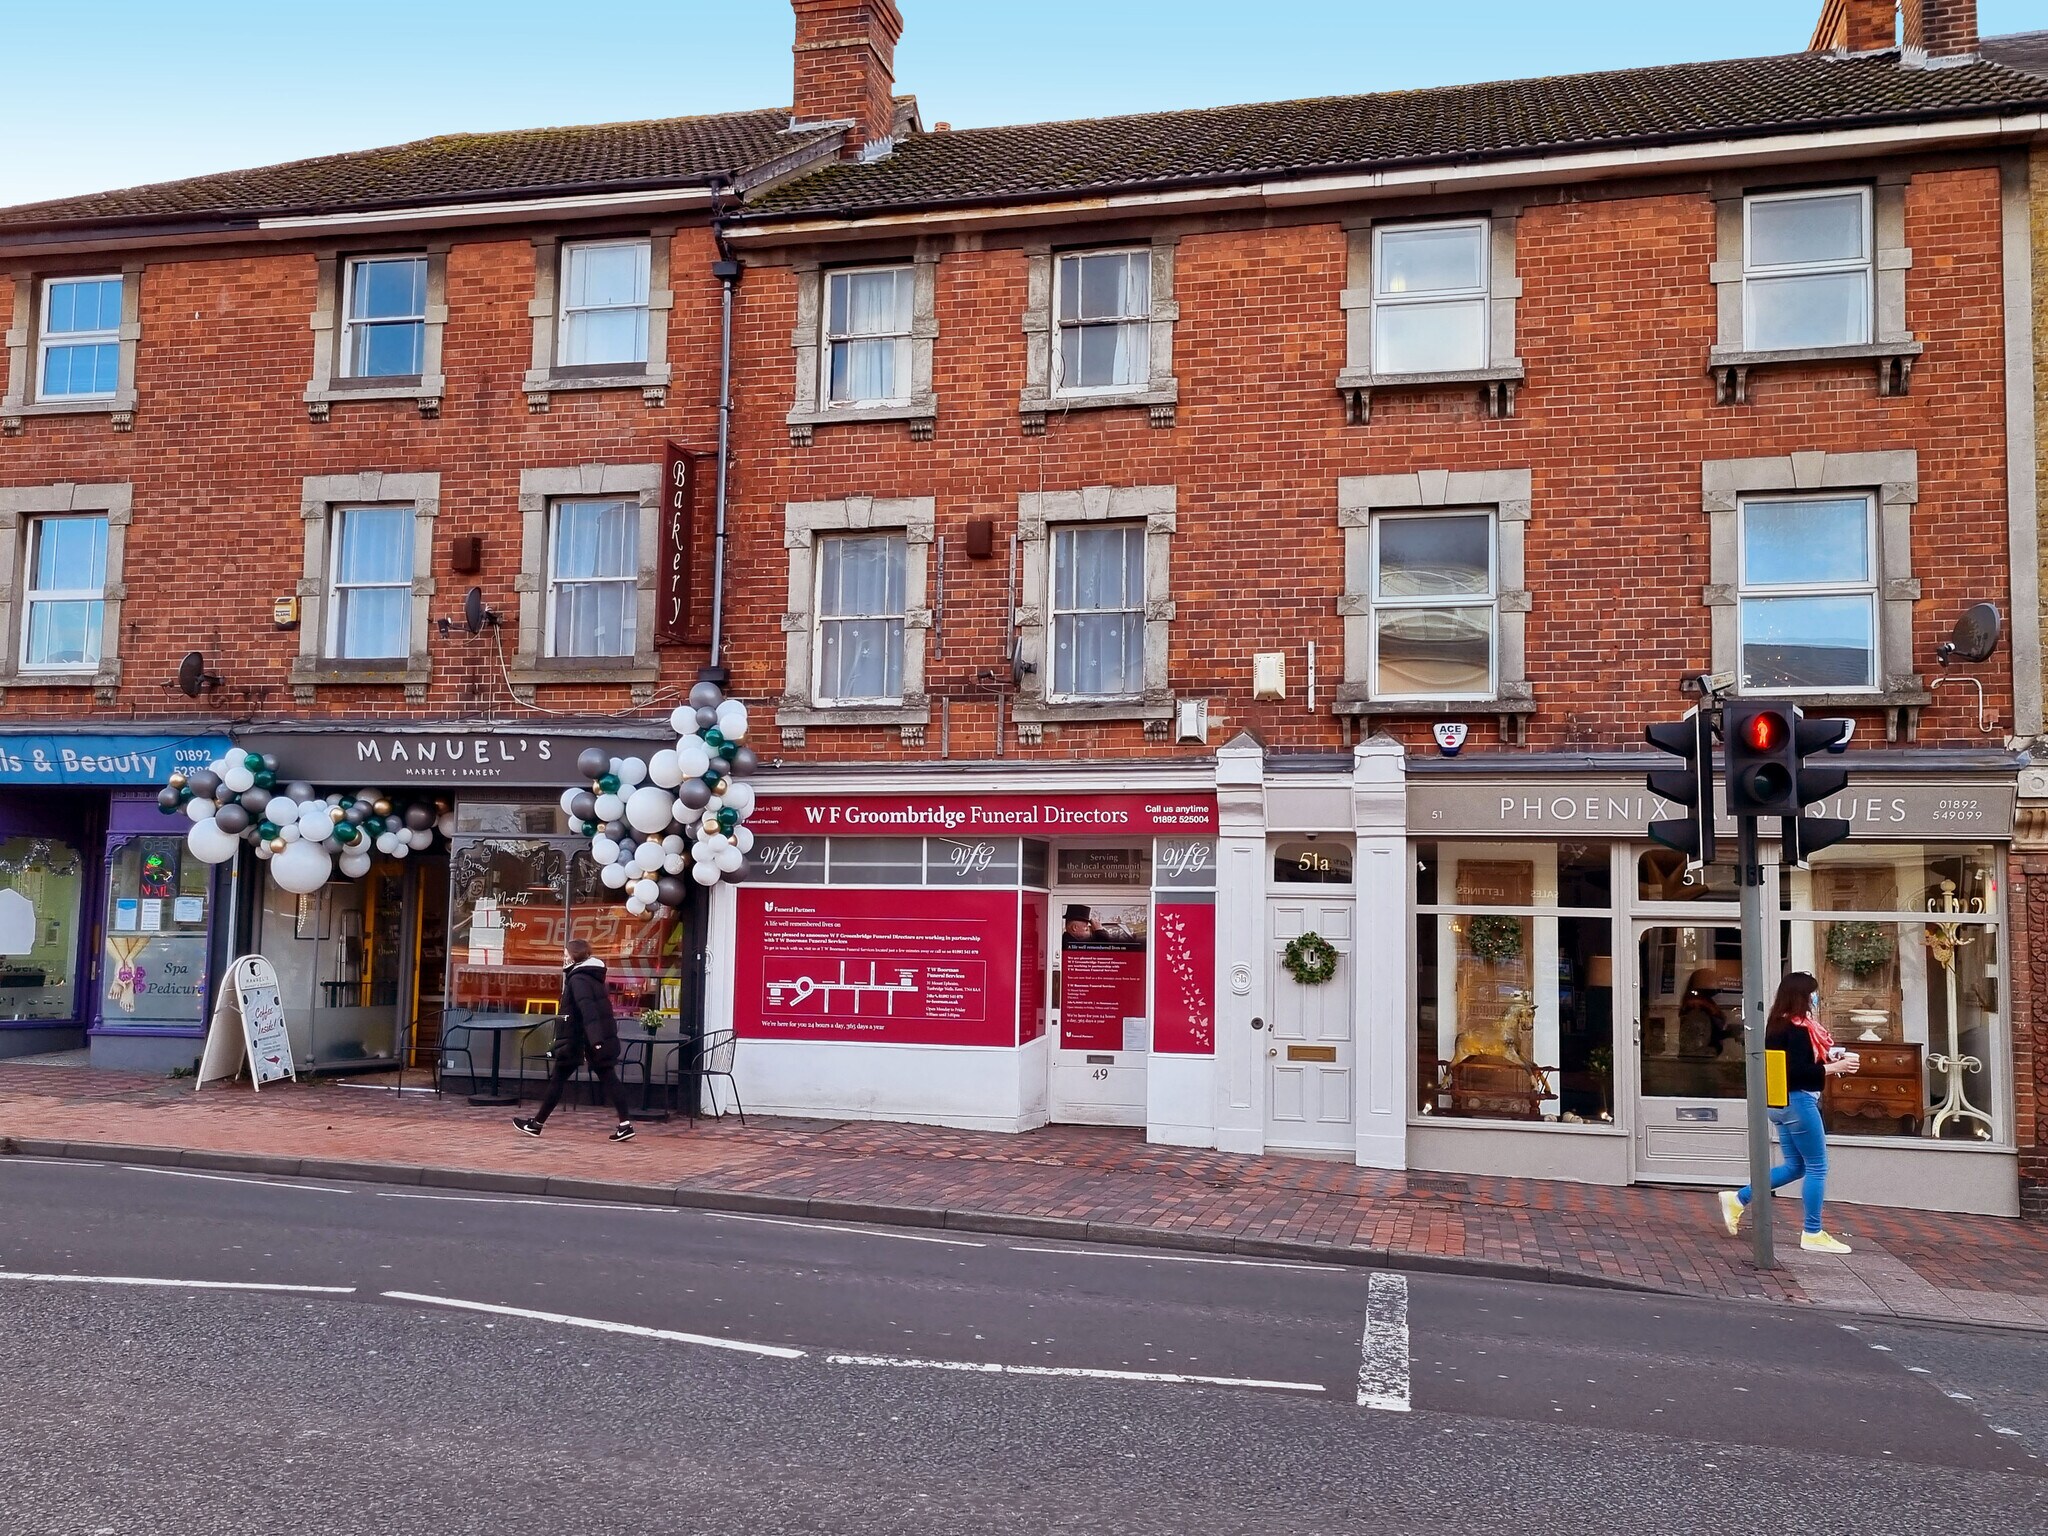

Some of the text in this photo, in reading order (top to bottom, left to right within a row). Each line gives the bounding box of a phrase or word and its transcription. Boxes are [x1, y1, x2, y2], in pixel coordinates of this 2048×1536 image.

[669, 460, 685, 625] Bakery
[175, 750, 212, 762] 01892
[357, 739, 552, 764] MANUEL'S
[0, 748, 156, 778] ls & Beauty
[1145, 805, 1161, 813] Call
[1175, 806, 1209, 815] anytime
[1500, 797, 1668, 820] PHOENIX
[1939, 800, 1977, 809] 01892
[805, 806, 1128, 828] W F Groombridge Funeral Directors
[1152, 816, 1209, 824] 01892 525004
[1431, 810, 1444, 819] 51
[1932, 811, 1982, 820] 549099
[143, 840, 178, 850] OPEN
[461, 854, 488, 875] Bread
[1090, 854, 1118, 863] Serving
[1298, 852, 1330, 870] 51a
[1682, 869, 1705, 886] 51
[494, 891, 532, 907] Market
[500, 916, 527, 931] Bakery
[164, 963, 188, 975] Spa
[147, 982, 204, 995] Pedicure
[255, 1004, 273, 1020] Coffee
[1092, 1069, 1108, 1081] 49
